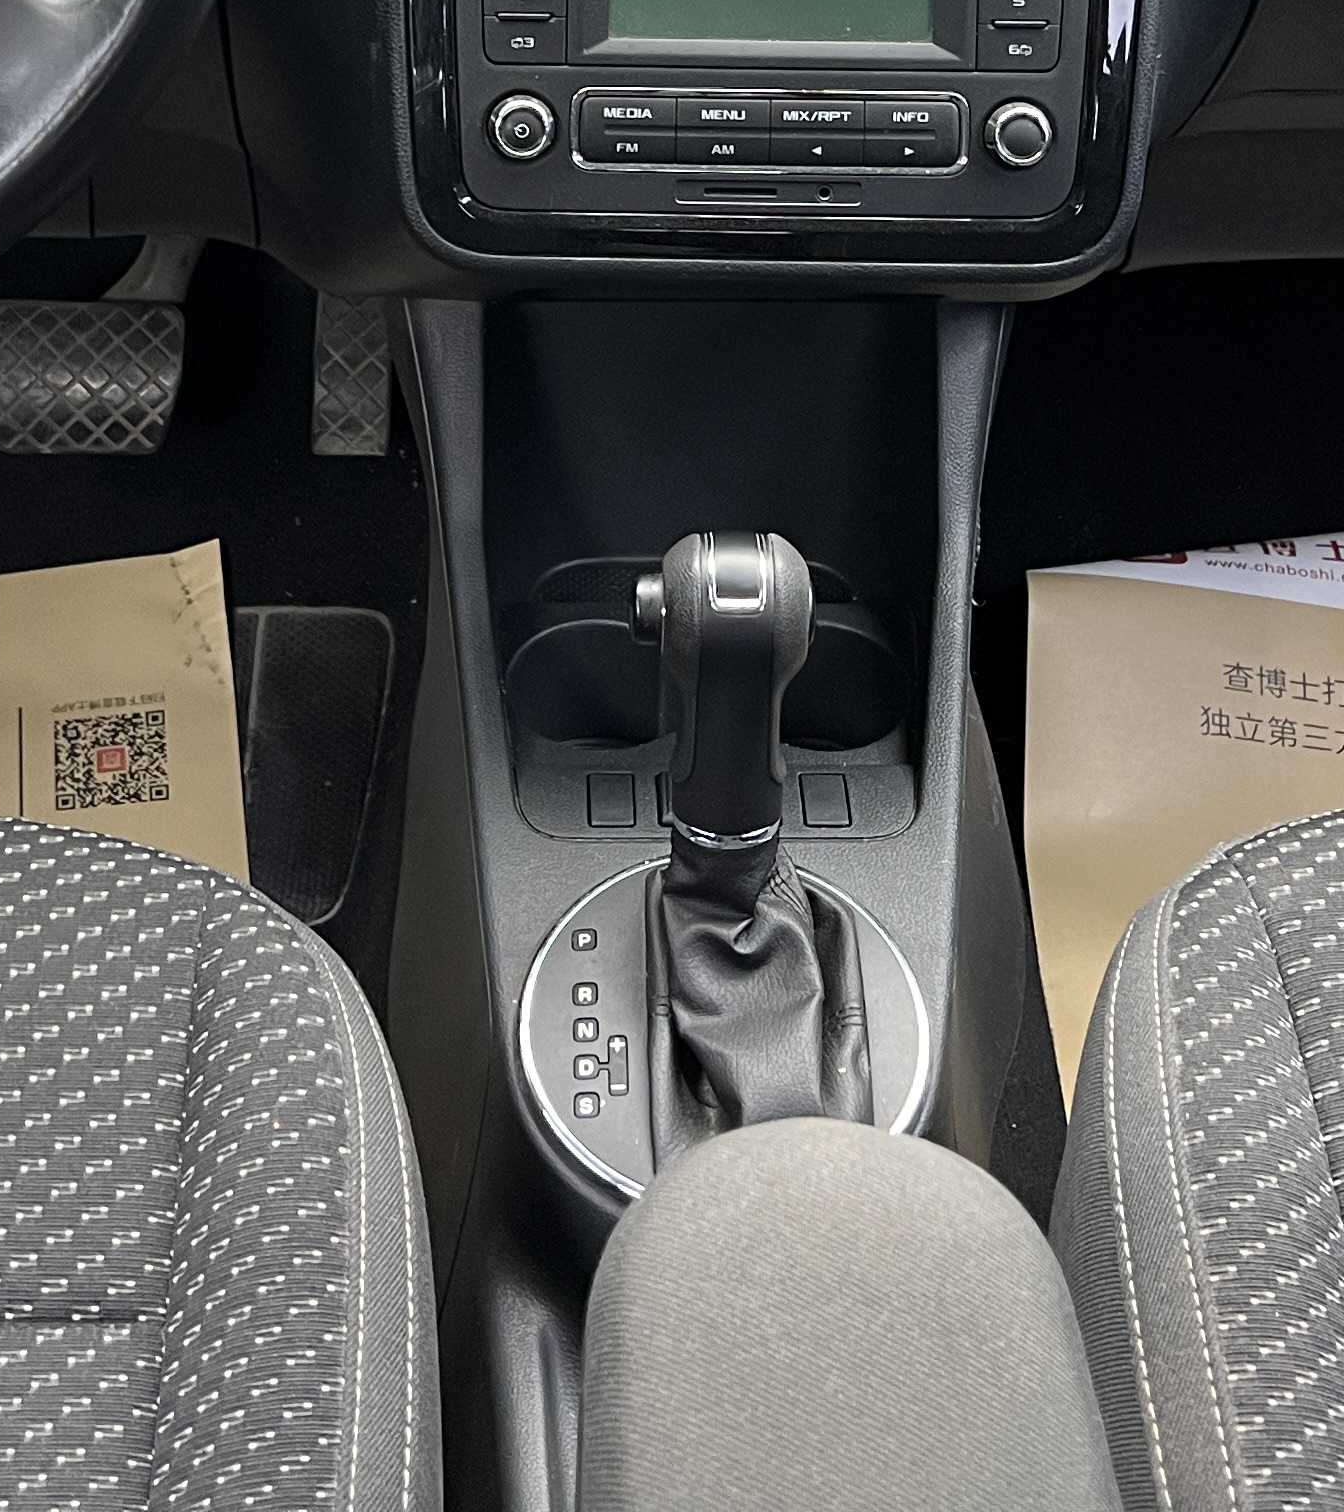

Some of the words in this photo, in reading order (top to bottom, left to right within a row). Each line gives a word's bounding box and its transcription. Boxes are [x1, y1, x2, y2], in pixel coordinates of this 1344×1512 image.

[603, 107, 653, 120] MEDIA
[701, 109, 746, 122] MENU
[782, 110, 852, 123] MIX/RPT
[892, 111, 930, 124] INFO
[616, 142, 639, 154] FM
[711, 144, 735, 156] AM
[578, 933, 592, 948] P
[578, 986, 593, 1003] R
[578, 1022, 594, 1039] N
[579, 1059, 595, 1076] D
[579, 1096, 594, 1115] S
